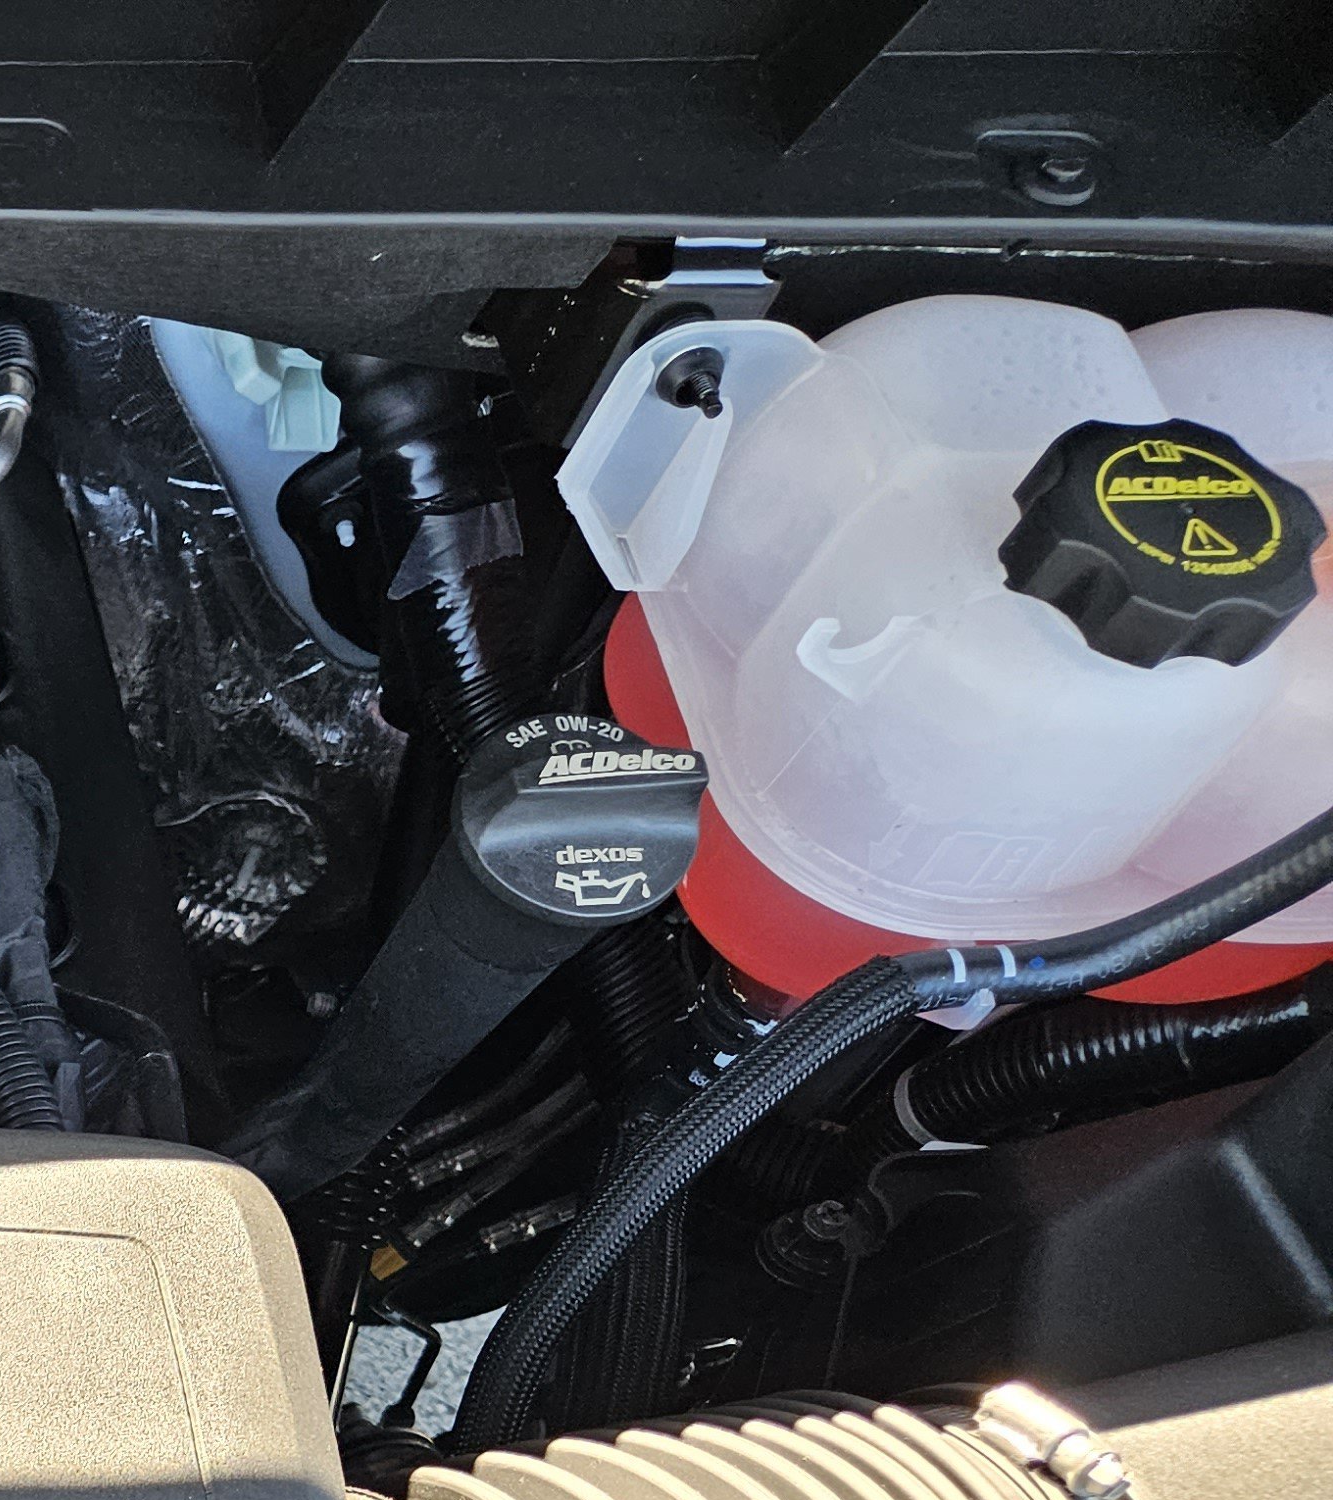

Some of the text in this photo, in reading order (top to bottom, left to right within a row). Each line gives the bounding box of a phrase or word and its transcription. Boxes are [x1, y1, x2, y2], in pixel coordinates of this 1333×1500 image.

[1108, 476, 1252, 495] ACDelco
[505, 716, 624, 748] SAE 0W-20
[538, 750, 696, 778] ACDelco
[555, 845, 644, 866] dexos
